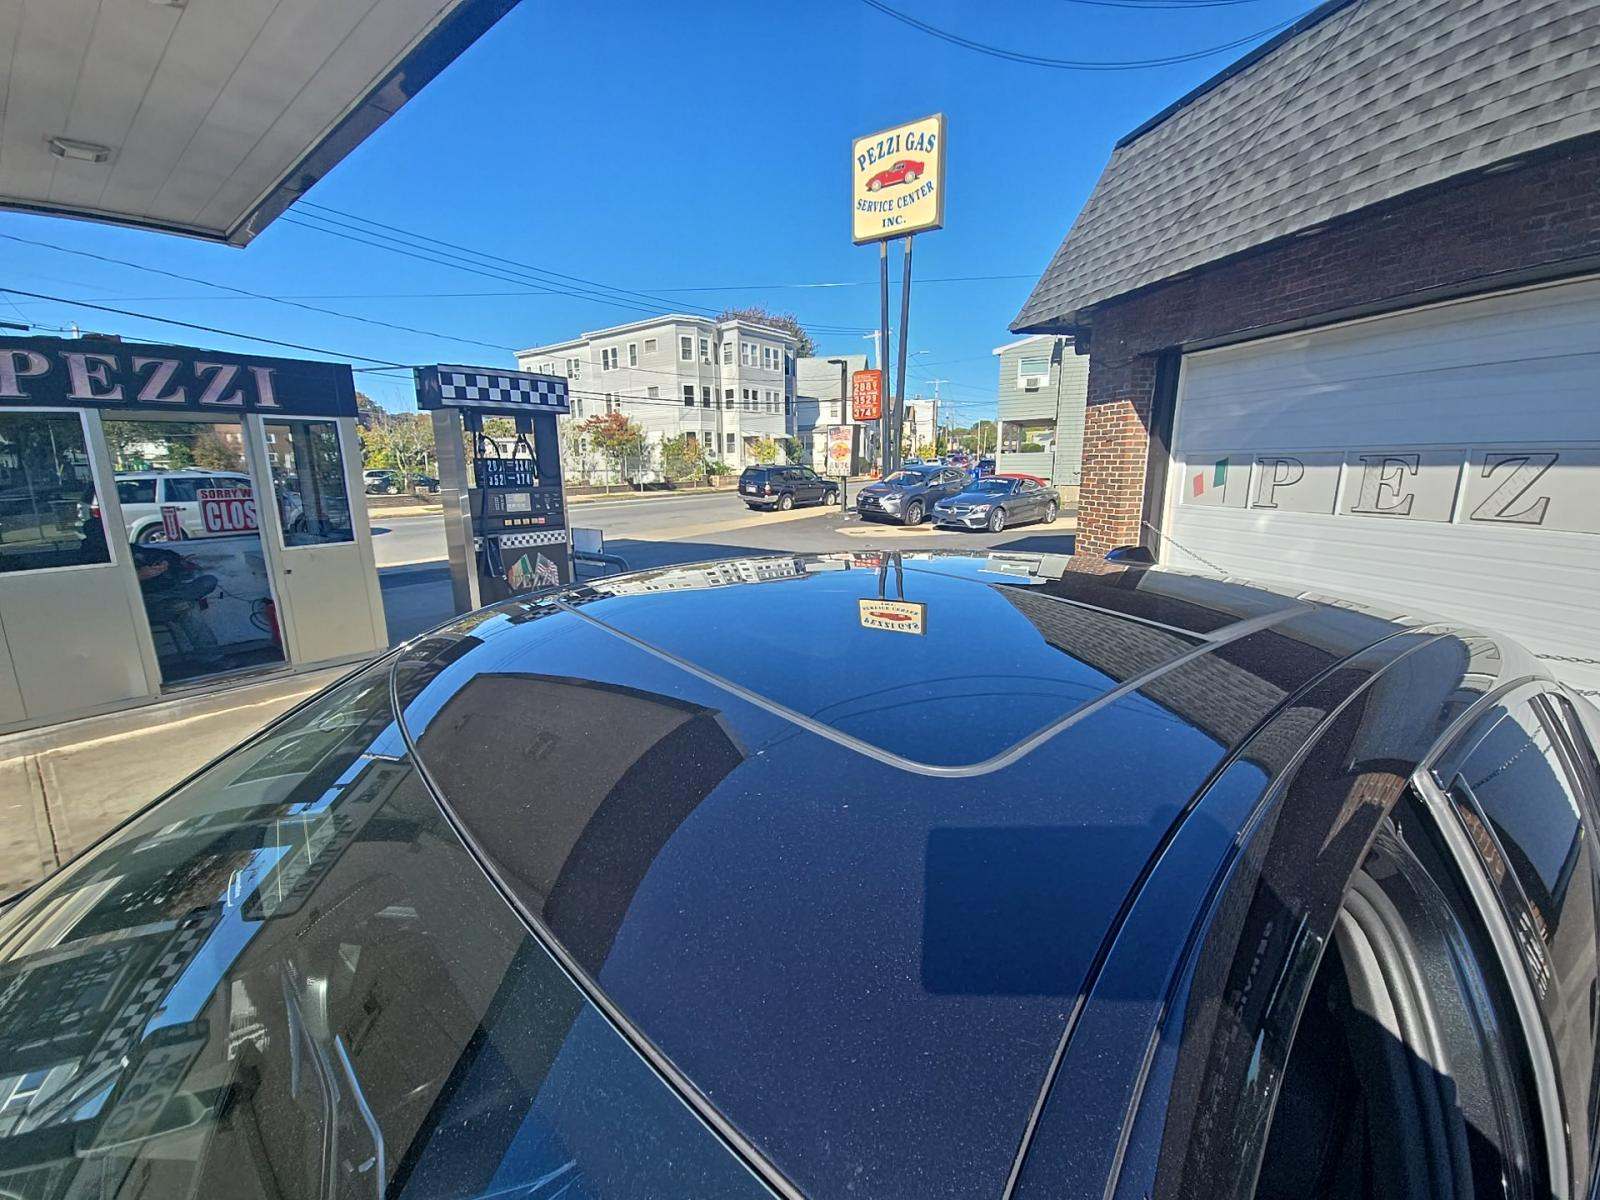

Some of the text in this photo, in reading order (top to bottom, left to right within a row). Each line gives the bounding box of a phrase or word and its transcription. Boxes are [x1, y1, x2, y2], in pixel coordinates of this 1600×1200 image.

[857, 131, 936, 172] PEZZI GAS
[856, 180, 935, 213] SERVICE CENTER
[882, 215, 907, 228] INC.
[0, 349, 282, 409] PEZZI
[854, 395, 872, 405] 352
[854, 407, 872, 417] 374
[200, 489, 239, 499] SORRY
[1252, 452, 1560, 525] PEZ
